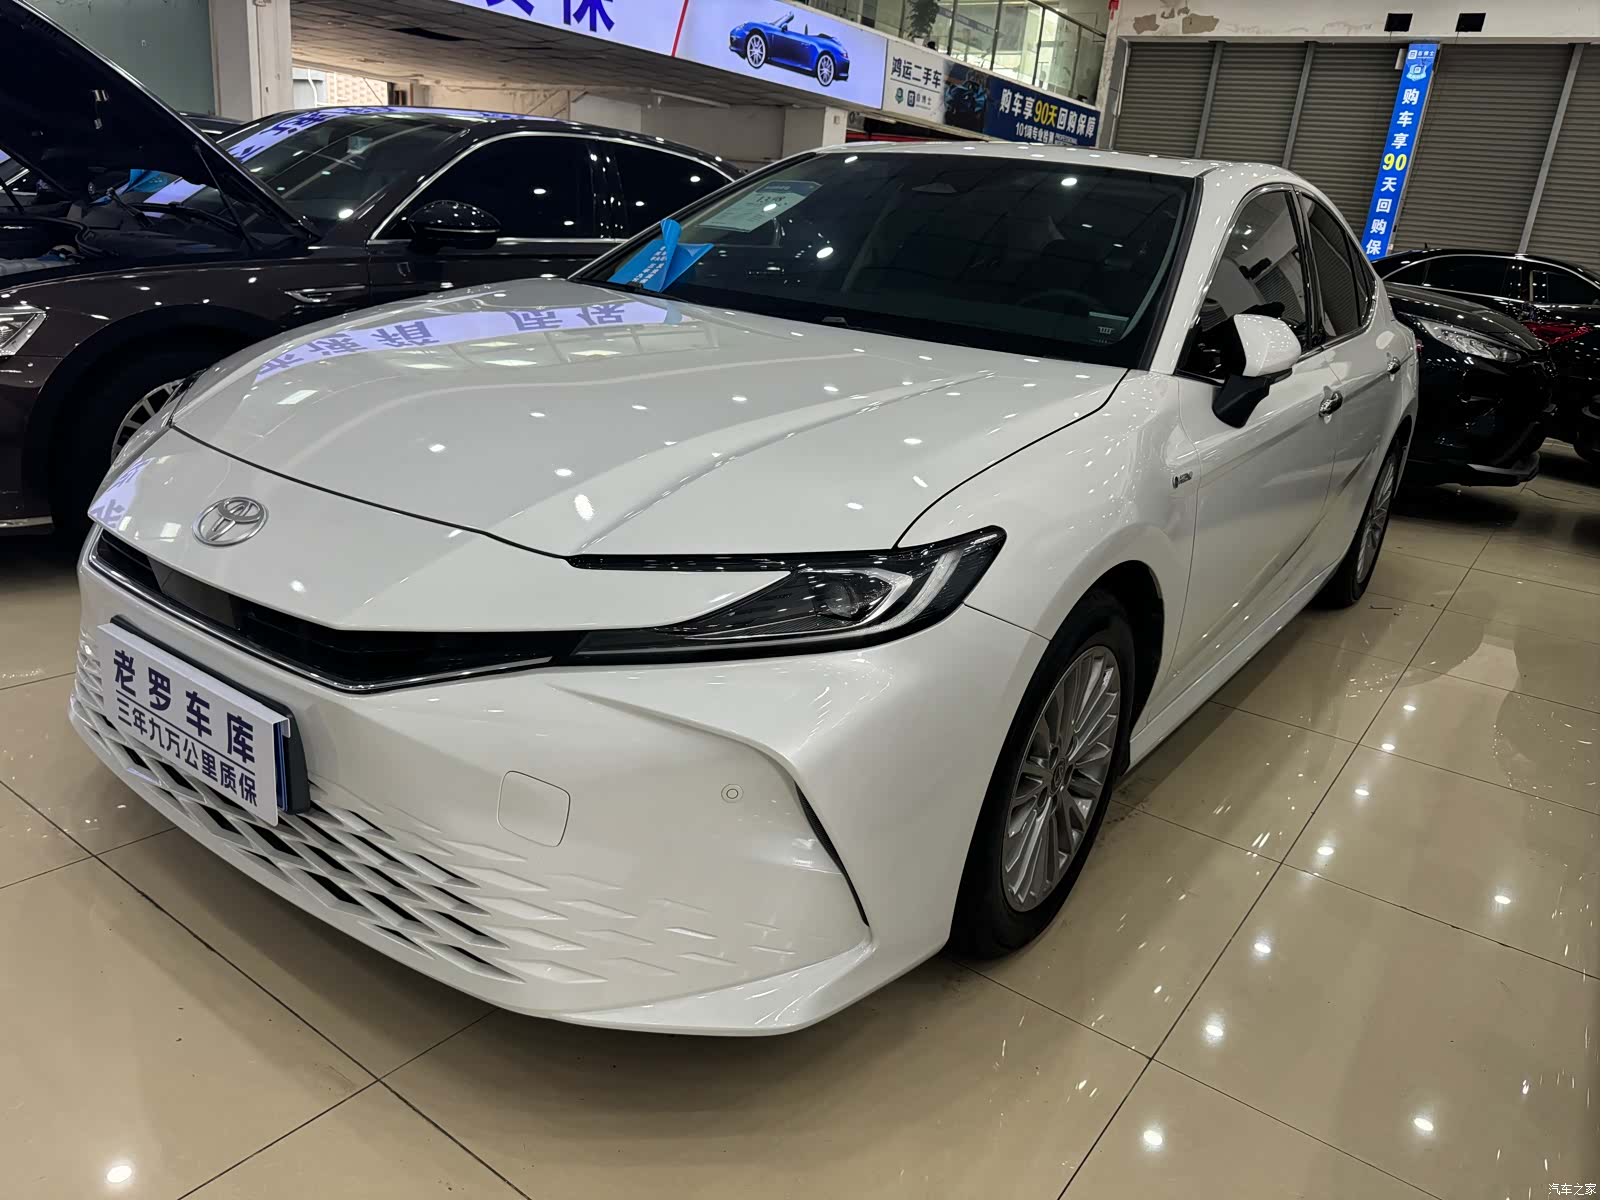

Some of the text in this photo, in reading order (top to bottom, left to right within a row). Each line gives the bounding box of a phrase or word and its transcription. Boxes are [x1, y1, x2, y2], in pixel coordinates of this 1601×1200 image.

[891, 56, 942, 89] 鸿运二手车
[999, 88, 1096, 138] 购车享90天回购保障
[1366, 88, 1420, 255] 购车享90天回购保
[113, 650, 255, 764] 老罗车库
[117, 697, 258, 807] 三年九万公里质保
